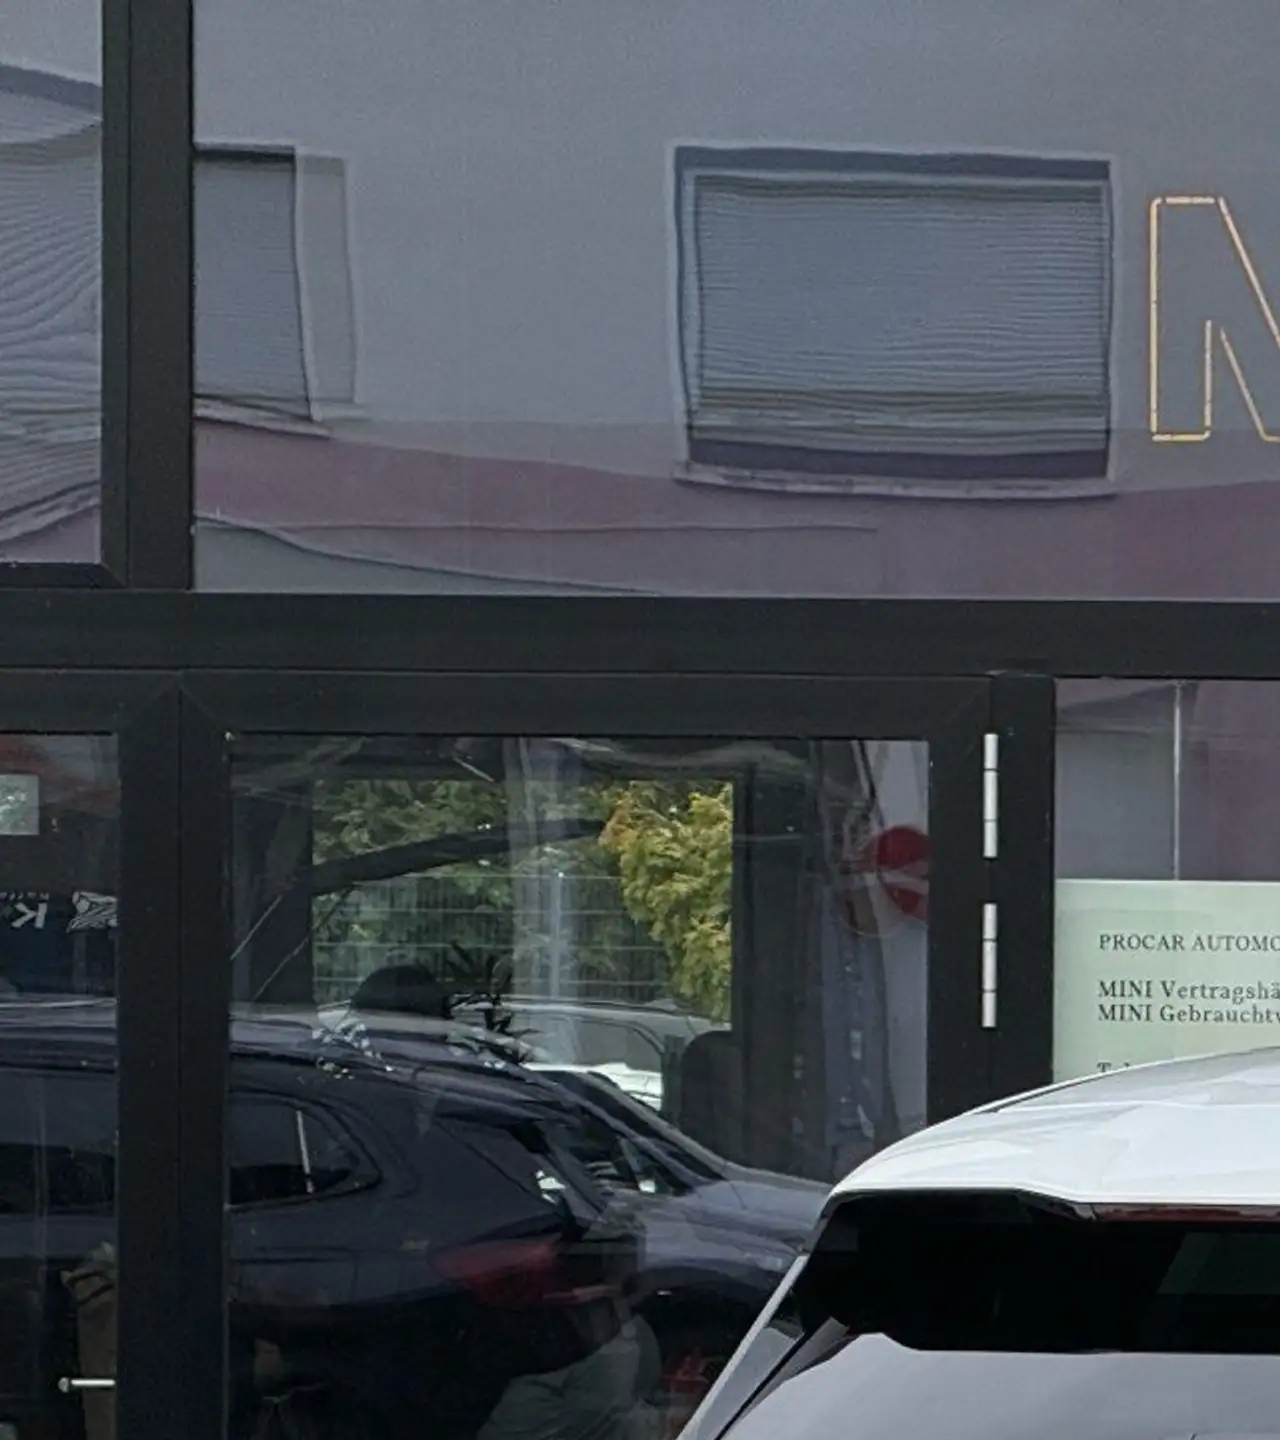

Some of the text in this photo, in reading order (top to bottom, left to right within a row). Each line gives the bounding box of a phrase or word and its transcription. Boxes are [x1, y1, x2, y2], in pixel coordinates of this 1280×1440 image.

[1099, 934, 1185, 951] PROCAR
[1098, 980, 1153, 999] MINI
[1098, 1004, 1152, 1022] MINI
